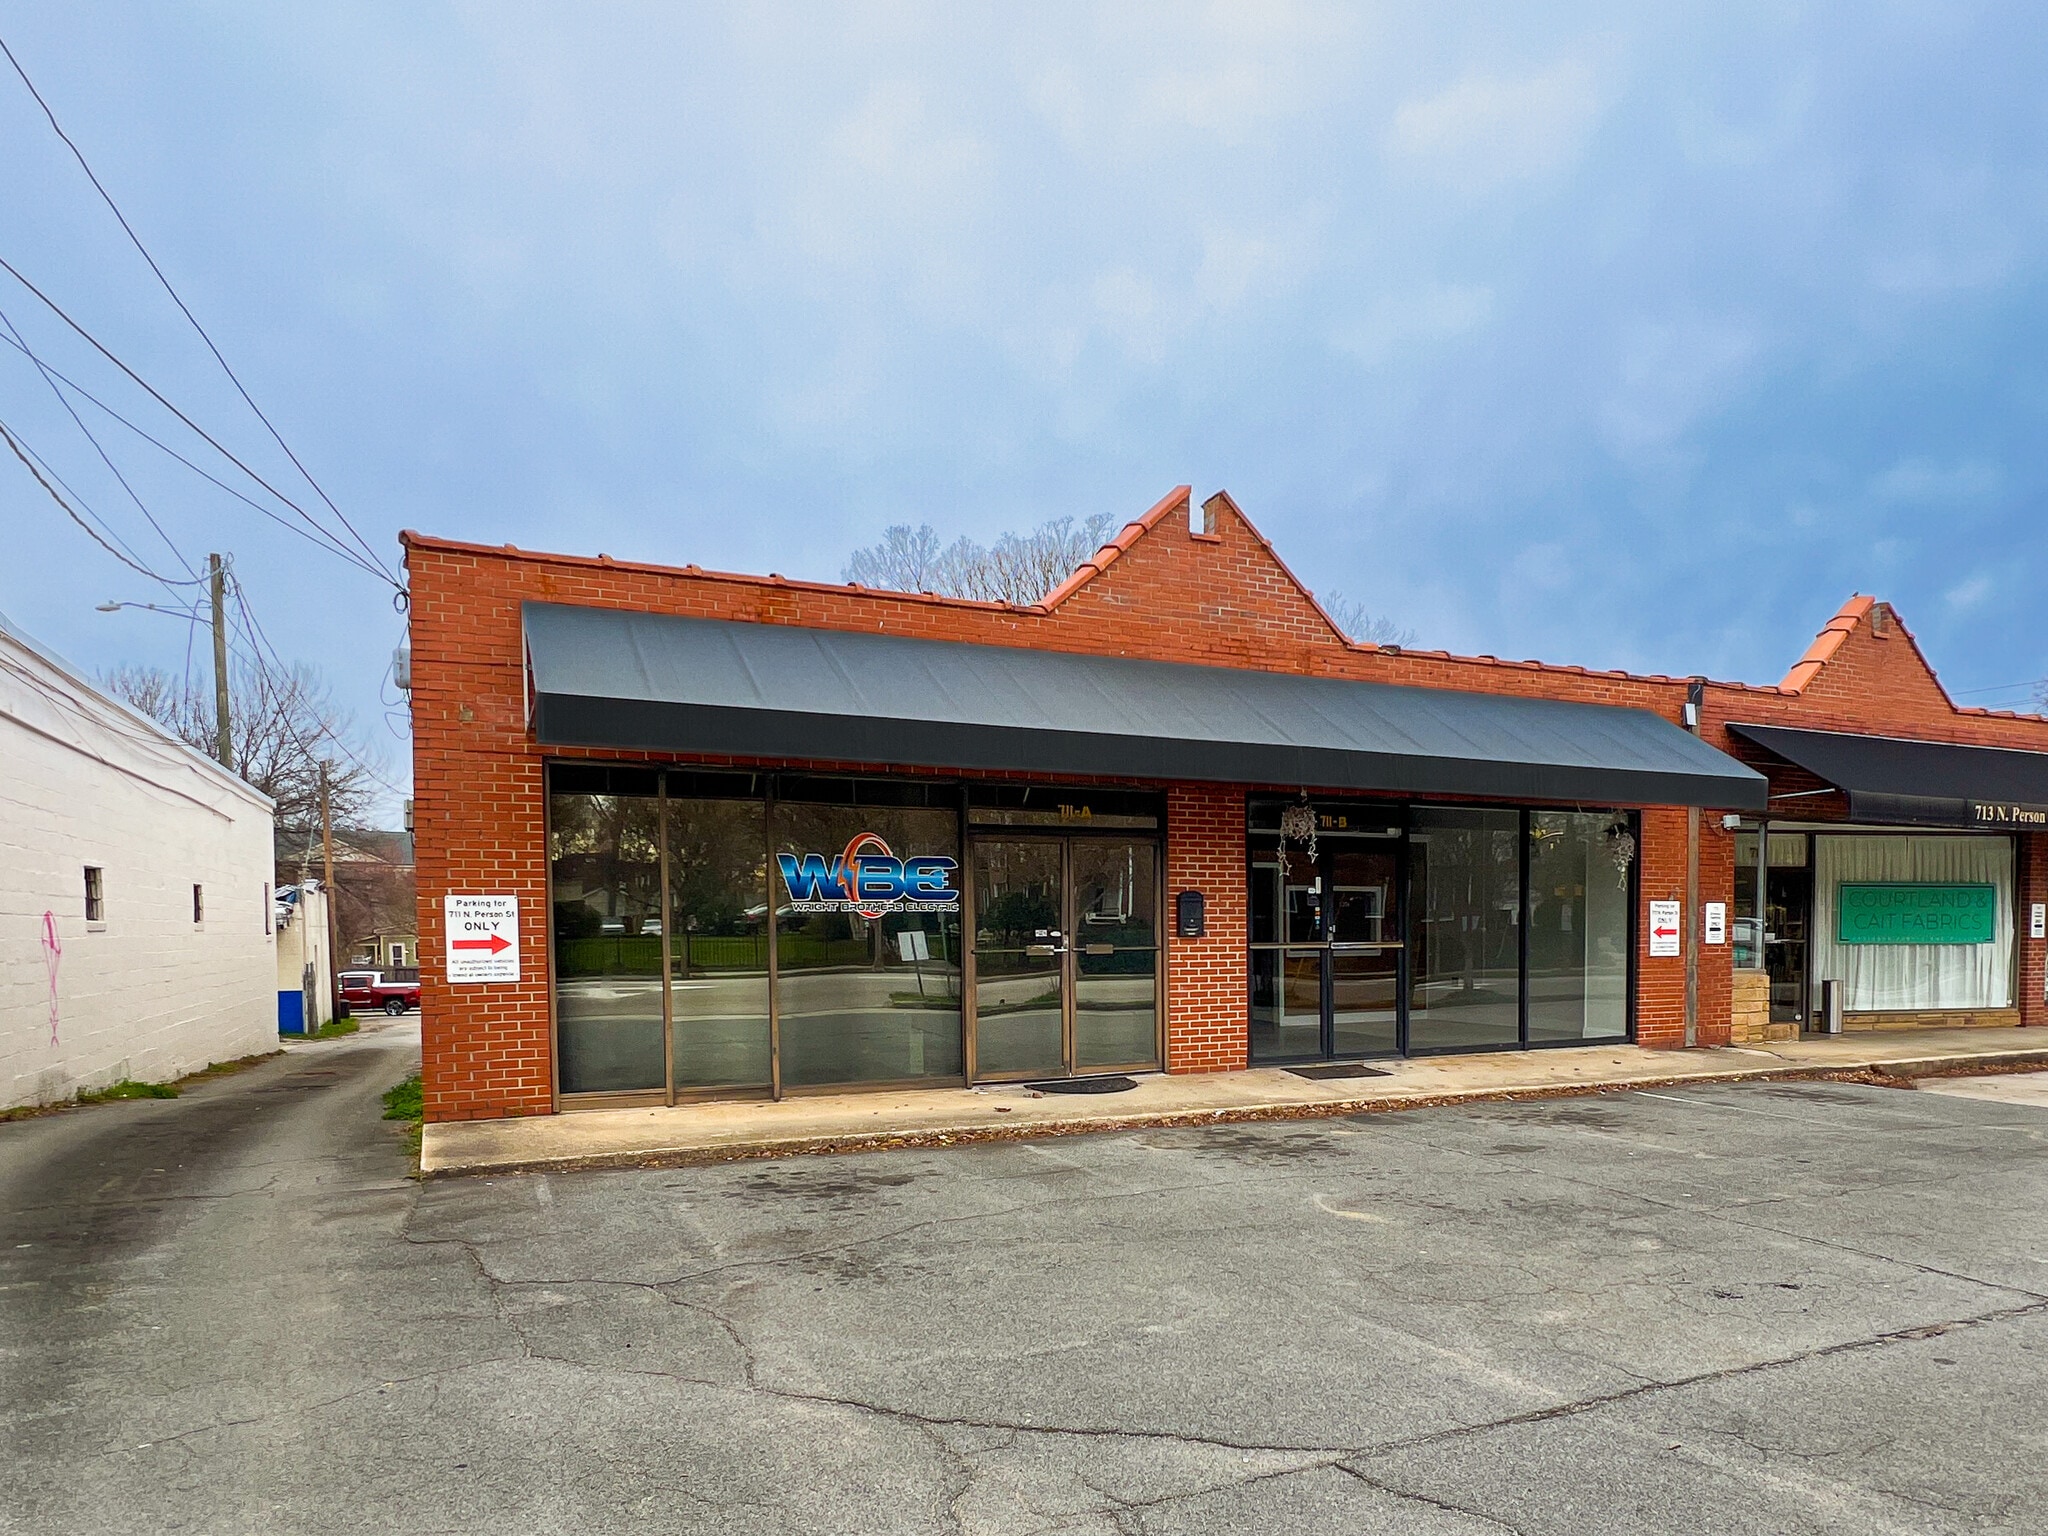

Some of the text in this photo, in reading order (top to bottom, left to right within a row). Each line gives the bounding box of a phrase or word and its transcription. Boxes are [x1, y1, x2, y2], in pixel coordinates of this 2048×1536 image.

[1057, 804, 1092, 818] 711-A
[1975, 804, 2046, 824] 713 N. Person
[1319, 815, 1347, 828] 711-B
[776, 853, 960, 902] WBE
[456, 899, 491, 908] Parking
[1850, 890, 1988, 909] COURTLAND &
[791, 901, 960, 913] WRIGHT BROTHERS ELECTRIC
[448, 910, 461, 918] 711
[474, 910, 504, 918] Person
[505, 910, 515, 918] St
[464, 921, 500, 931] ONLY
[1853, 913, 1983, 930] CAIT FABRICS
